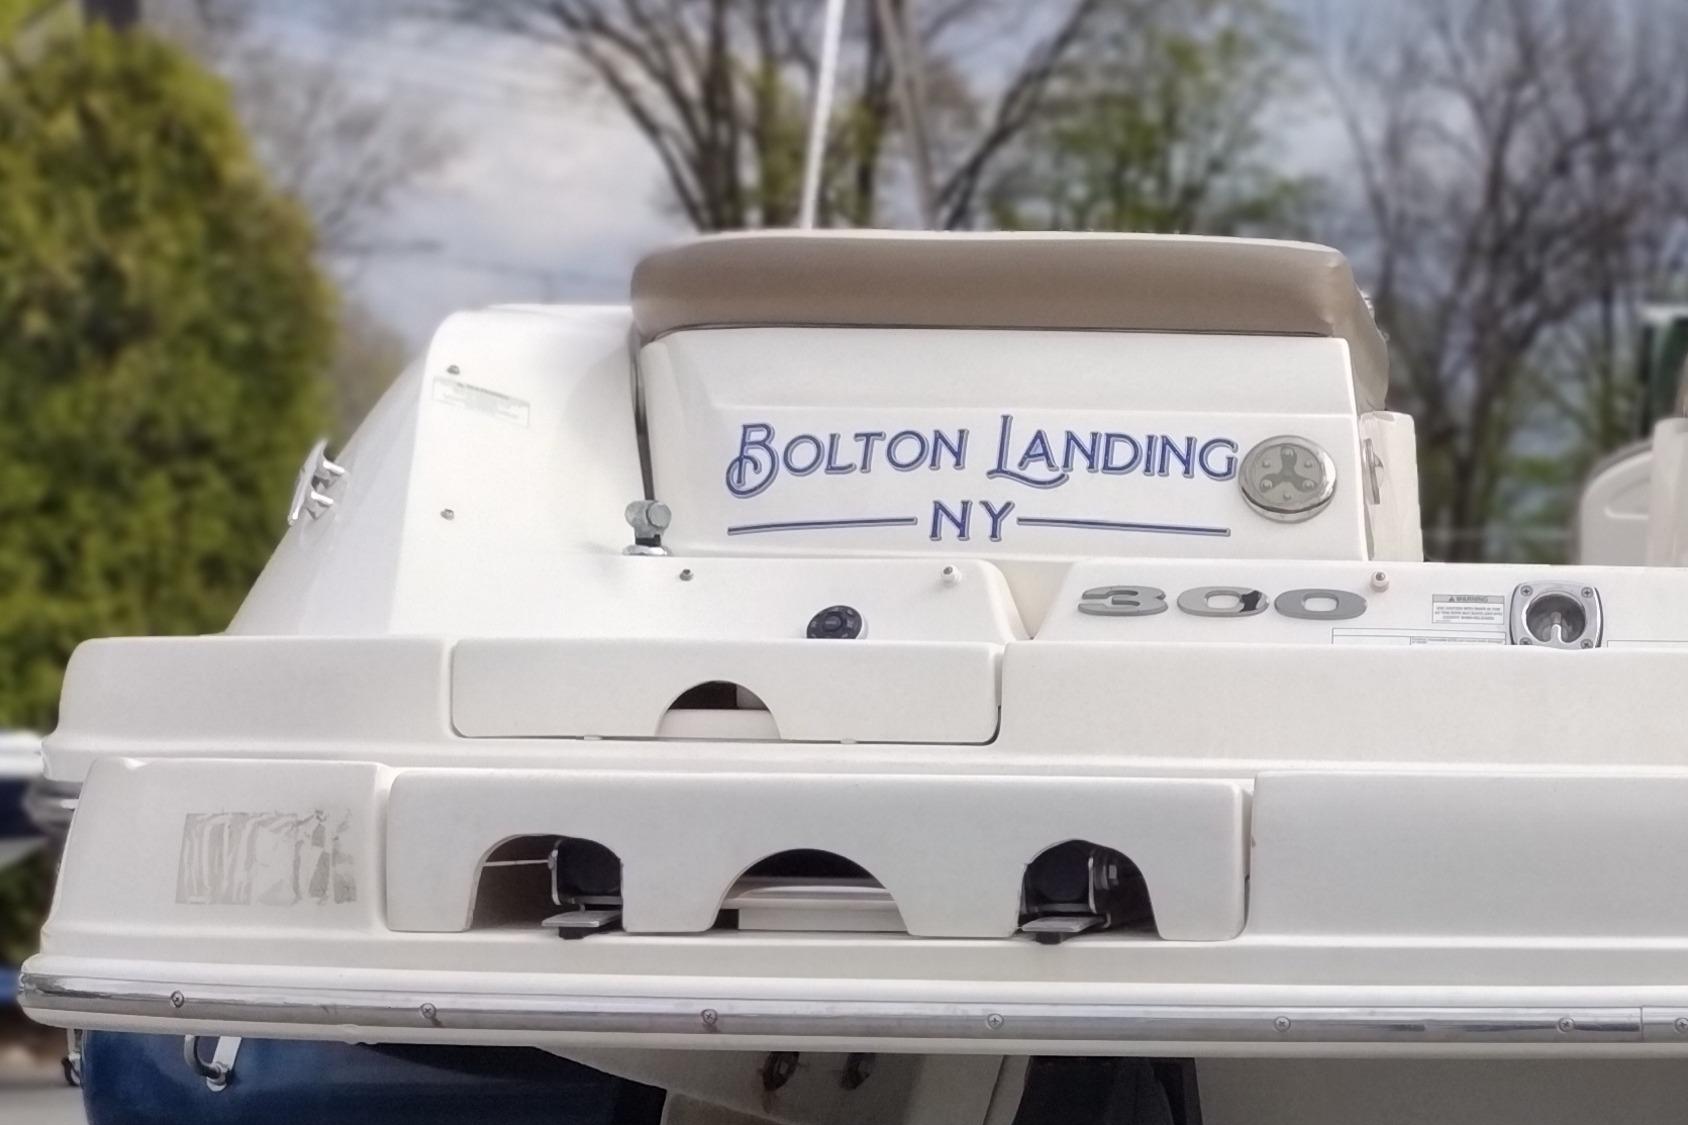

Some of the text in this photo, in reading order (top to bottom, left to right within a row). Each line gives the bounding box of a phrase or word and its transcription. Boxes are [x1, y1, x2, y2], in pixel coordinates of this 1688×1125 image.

[725, 414, 1239, 498] BOLTON LANDING
[929, 500, 1015, 542] NY
[1077, 585, 1368, 620] 300
